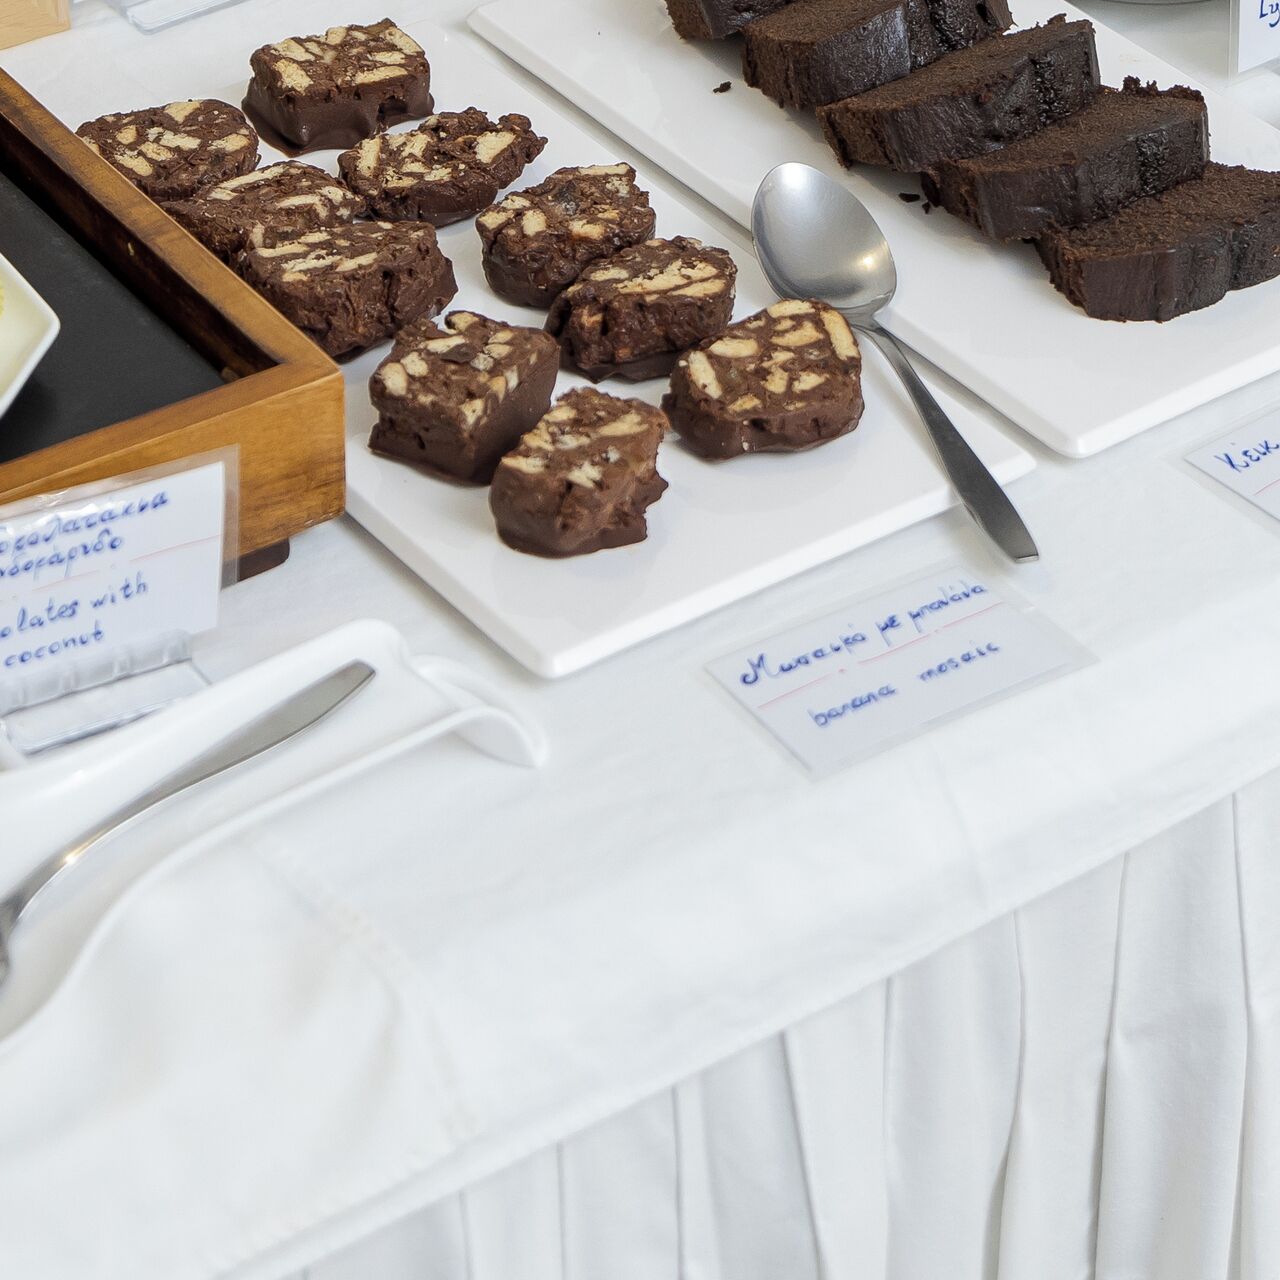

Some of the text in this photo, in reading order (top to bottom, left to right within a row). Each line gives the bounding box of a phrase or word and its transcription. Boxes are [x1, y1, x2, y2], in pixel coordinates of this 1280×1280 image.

[91, 571, 149, 609] with
[875, 614, 902, 647] με
[908, 580, 987, 634] μπανάνα
[4, 620, 105, 667] coconut
[807, 641, 1001, 729] banana mosaic
